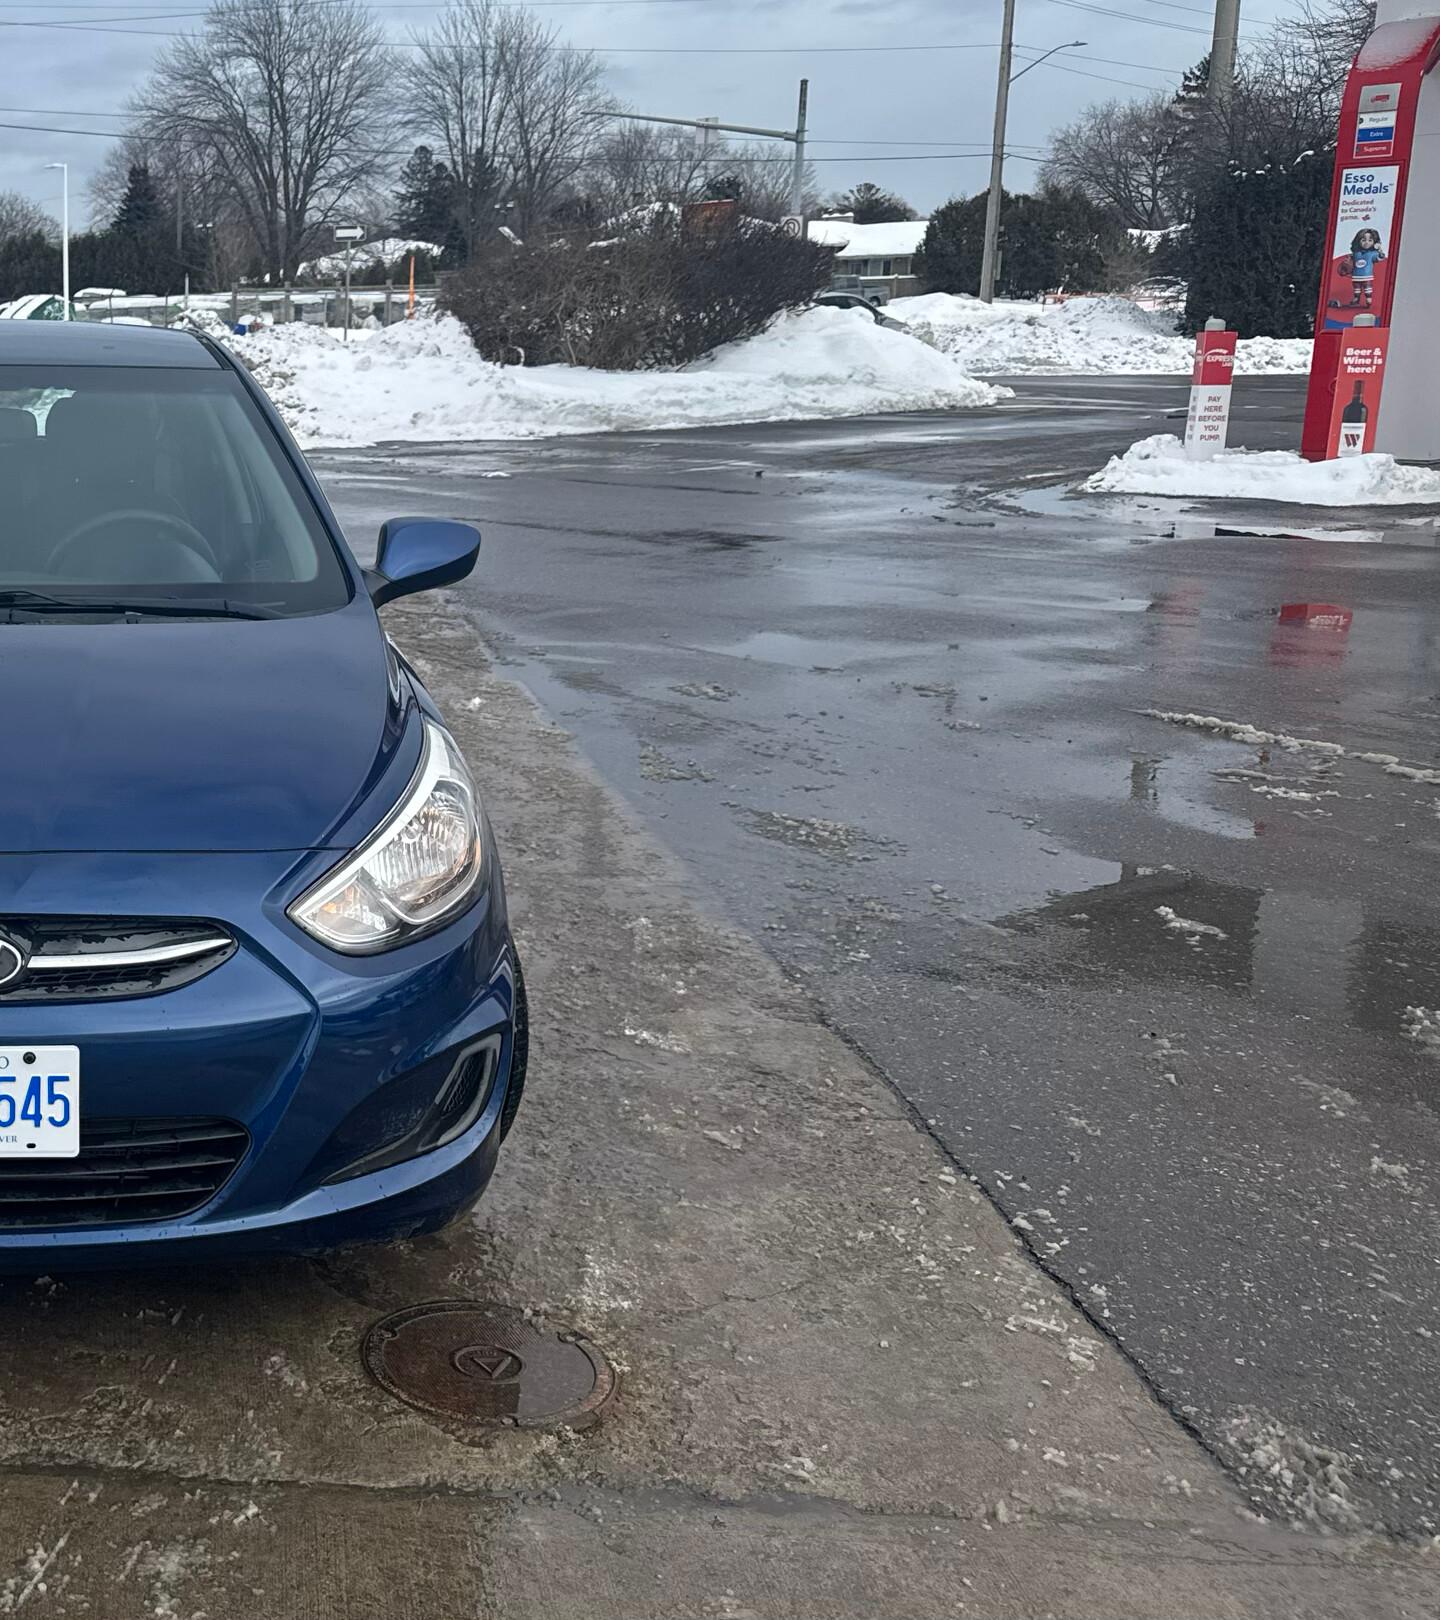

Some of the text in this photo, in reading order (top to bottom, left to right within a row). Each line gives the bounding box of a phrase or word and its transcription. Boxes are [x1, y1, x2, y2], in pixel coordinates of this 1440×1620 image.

[1344, 173, 1375, 183] Esso
[1346, 347, 1382, 356] Beer &
[1343, 356, 1383, 365] Wine is
[1346, 365, 1377, 374] here!
[1208, 395, 1222, 403] PAY
